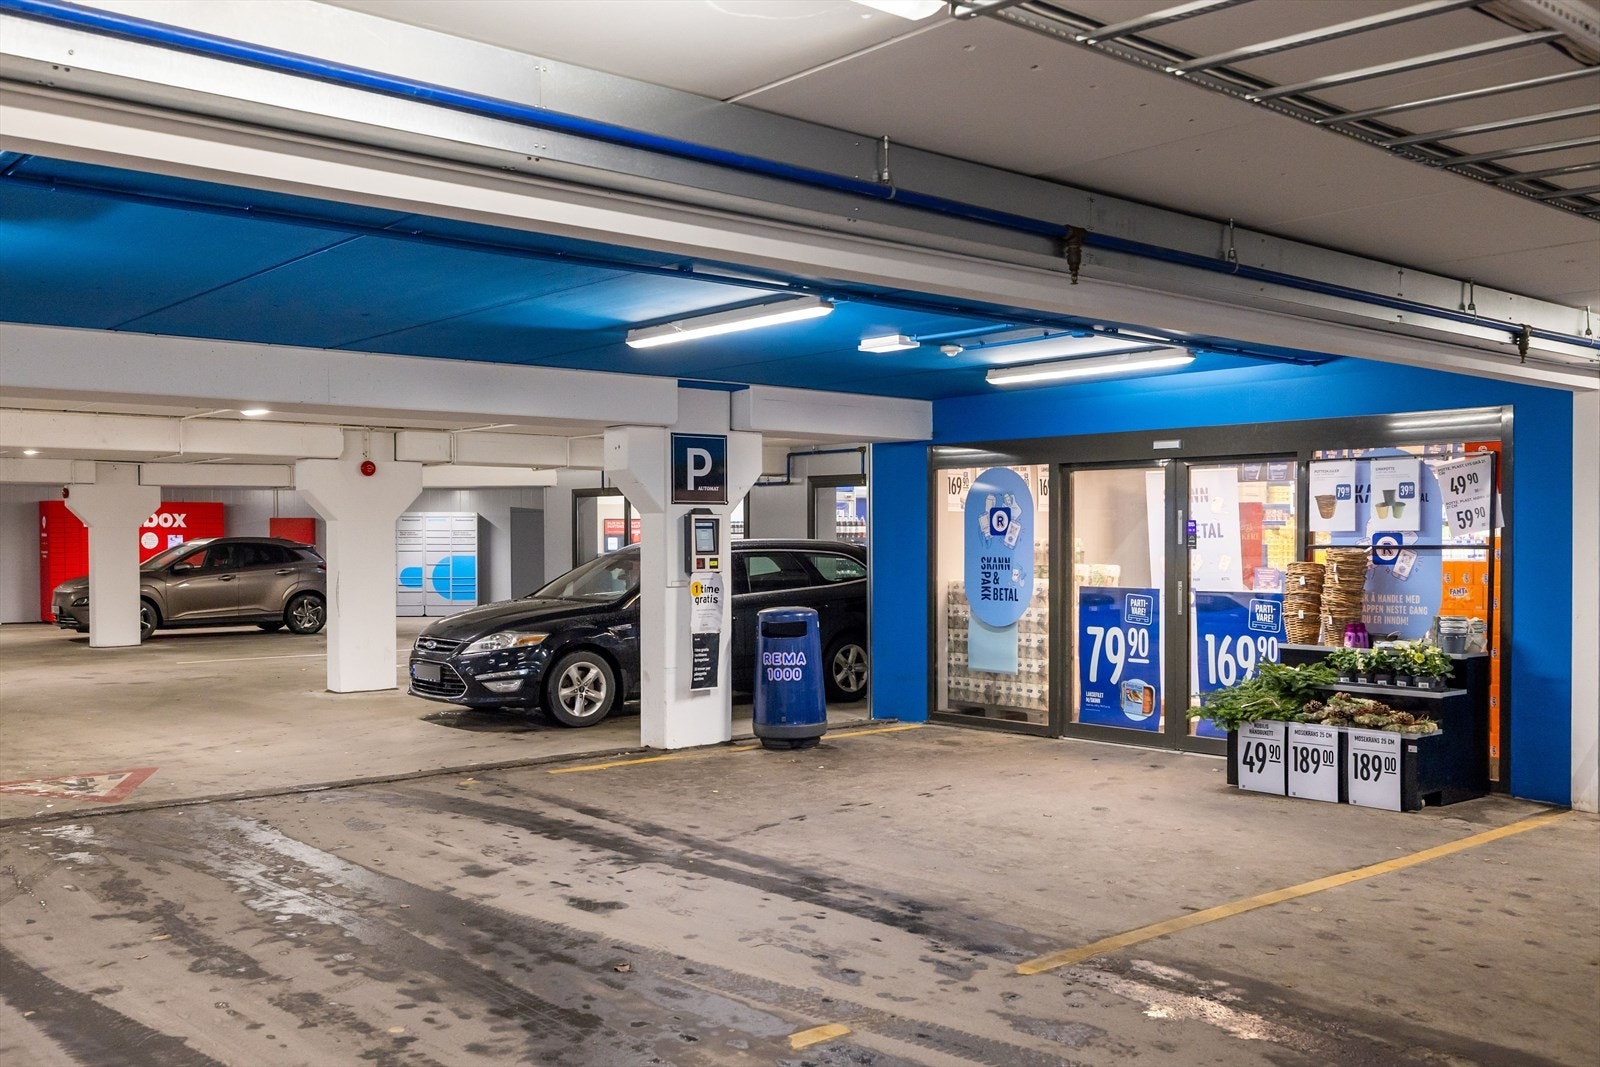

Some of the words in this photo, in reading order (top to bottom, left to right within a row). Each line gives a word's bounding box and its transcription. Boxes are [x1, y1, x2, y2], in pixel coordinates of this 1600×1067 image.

[687, 447, 712, 490] P
[948, 477, 961, 495] 169
[1040, 479, 1048, 496] 16
[1400, 485, 1409, 496] 39
[1450, 475, 1466, 495] 49
[1467, 472, 1479, 485] 90
[1337, 487, 1345, 498] 79
[143, 513, 187, 528] box
[996, 514, 1005, 528] R
[1457, 509, 1473, 530] 59
[1474, 506, 1486, 519] 90
[1196, 522, 1224, 539] TAL
[981, 556, 1010, 570] SKANN
[993, 571, 1000, 585] &
[694, 584, 699, 593] 1
[701, 584, 720, 594] time
[981, 571, 991, 601] PAKK
[694, 594, 718, 606] gratis
[993, 587, 1019, 602] BETAL
[1371, 592, 1376, 602] Å
[1377, 594, 1402, 604] HANDLE
[1405, 594, 1420, 604] MED
[1130, 598, 1149, 607] PARTI-
[1255, 604, 1276, 613] PARTI-
[1131, 607, 1147, 617] VARE!
[1386, 605, 1406, 614] NESTE
[1409, 605, 1428, 615] GANG
[1256, 613, 1274, 623] VARE!
[1361, 614, 1371, 624] DU
[1373, 616, 1382, 625] ER
[1384, 616, 1409, 626] INNOM!
[762, 651, 807, 666] REMA
[1086, 626, 1126, 685] 79
[1127, 627, 1149, 658] 90
[1205, 633, 1256, 687] 169
[1257, 635, 1278, 663] 90
[767, 667, 802, 682] 1000
[1294, 729, 1319, 738] MOSEKRANS
[1354, 735, 1380, 744] MOSEKRANS
[1242, 741, 1267, 774] 49
[1269, 744, 1281, 760] 90
[1292, 745, 1321, 775] 189
[1322, 749, 1334, 765] 00
[1353, 752, 1382, 782] 189
[1384, 756, 1397, 772] 00
